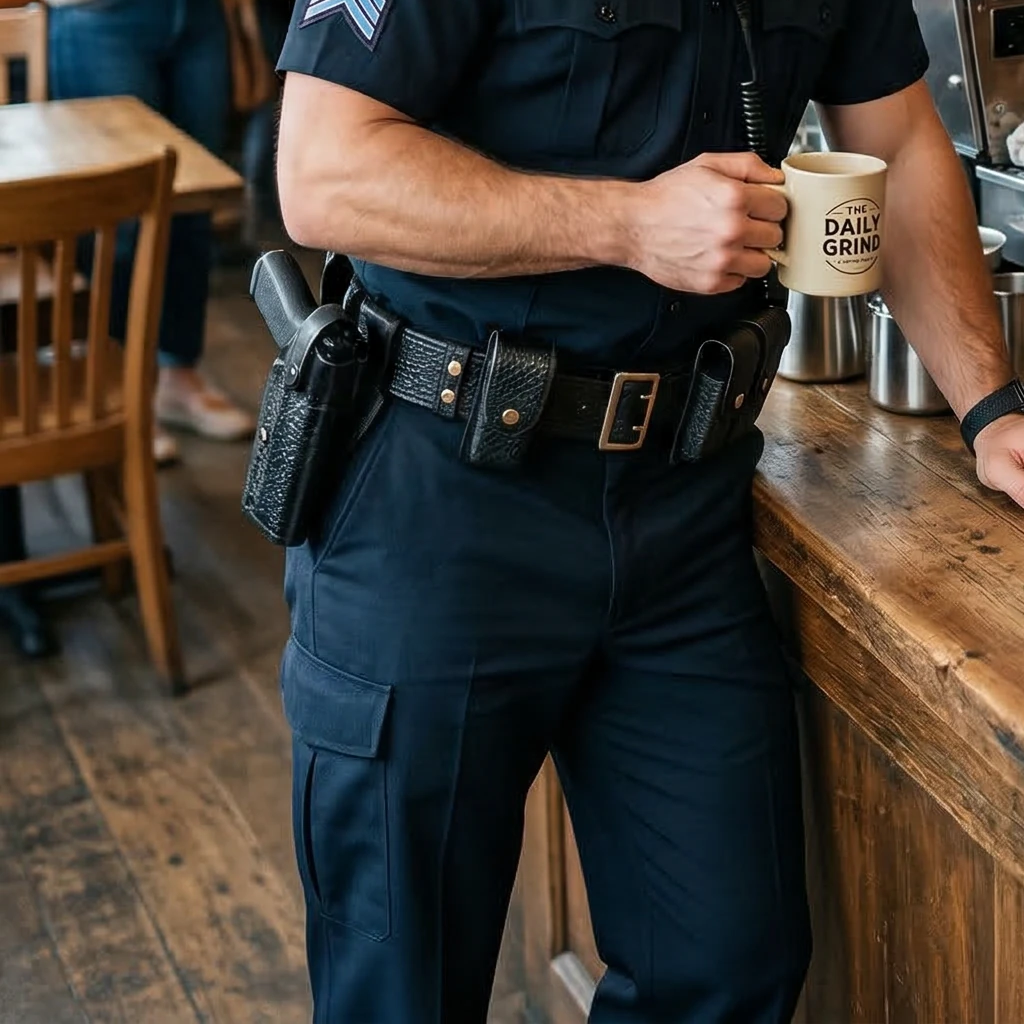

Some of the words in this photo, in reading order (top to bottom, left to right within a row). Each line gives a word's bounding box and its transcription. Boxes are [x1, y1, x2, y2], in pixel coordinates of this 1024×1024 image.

[846, 205, 867, 215] THE
[825, 213, 880, 236] DAILY
[823, 234, 880, 256] GRIND
